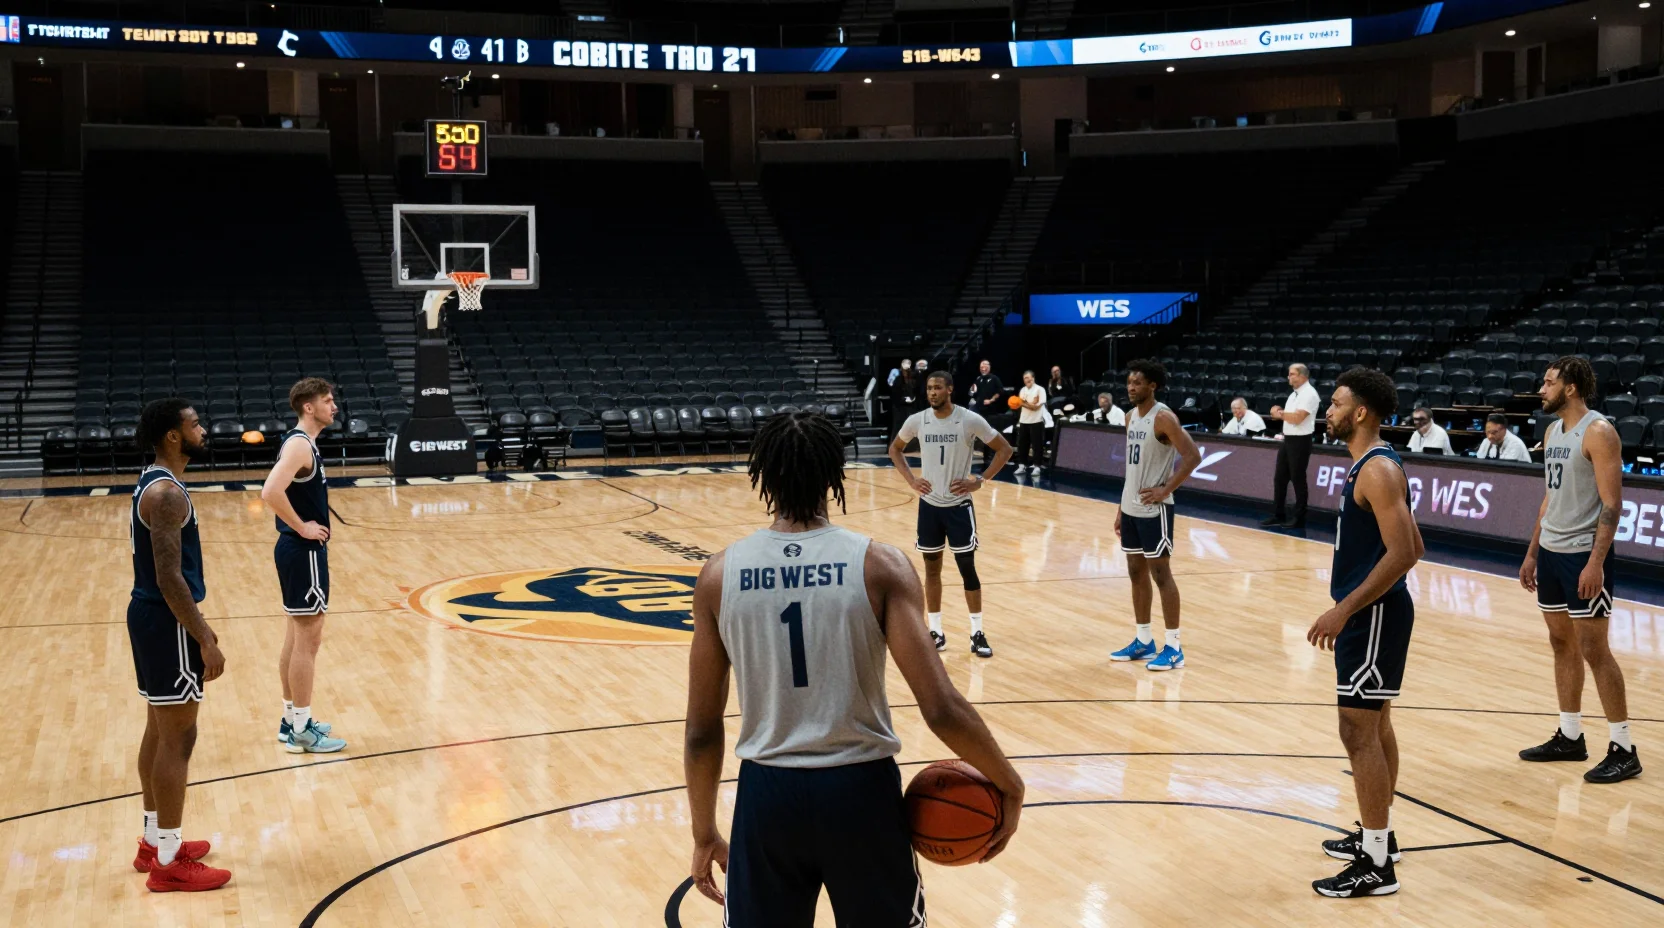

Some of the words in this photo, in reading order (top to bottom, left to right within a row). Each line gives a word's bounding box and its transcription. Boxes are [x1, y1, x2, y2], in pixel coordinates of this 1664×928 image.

[481, 38, 504, 62] 41
[1076, 299, 1130, 318] WES
[939, 445, 945, 466] 1
[1128, 443, 1141, 465] 18
[1430, 477, 1493, 520] WES
[740, 567, 776, 591] BIG
[779, 562, 848, 589] WEST
[779, 601, 809, 688] 1
